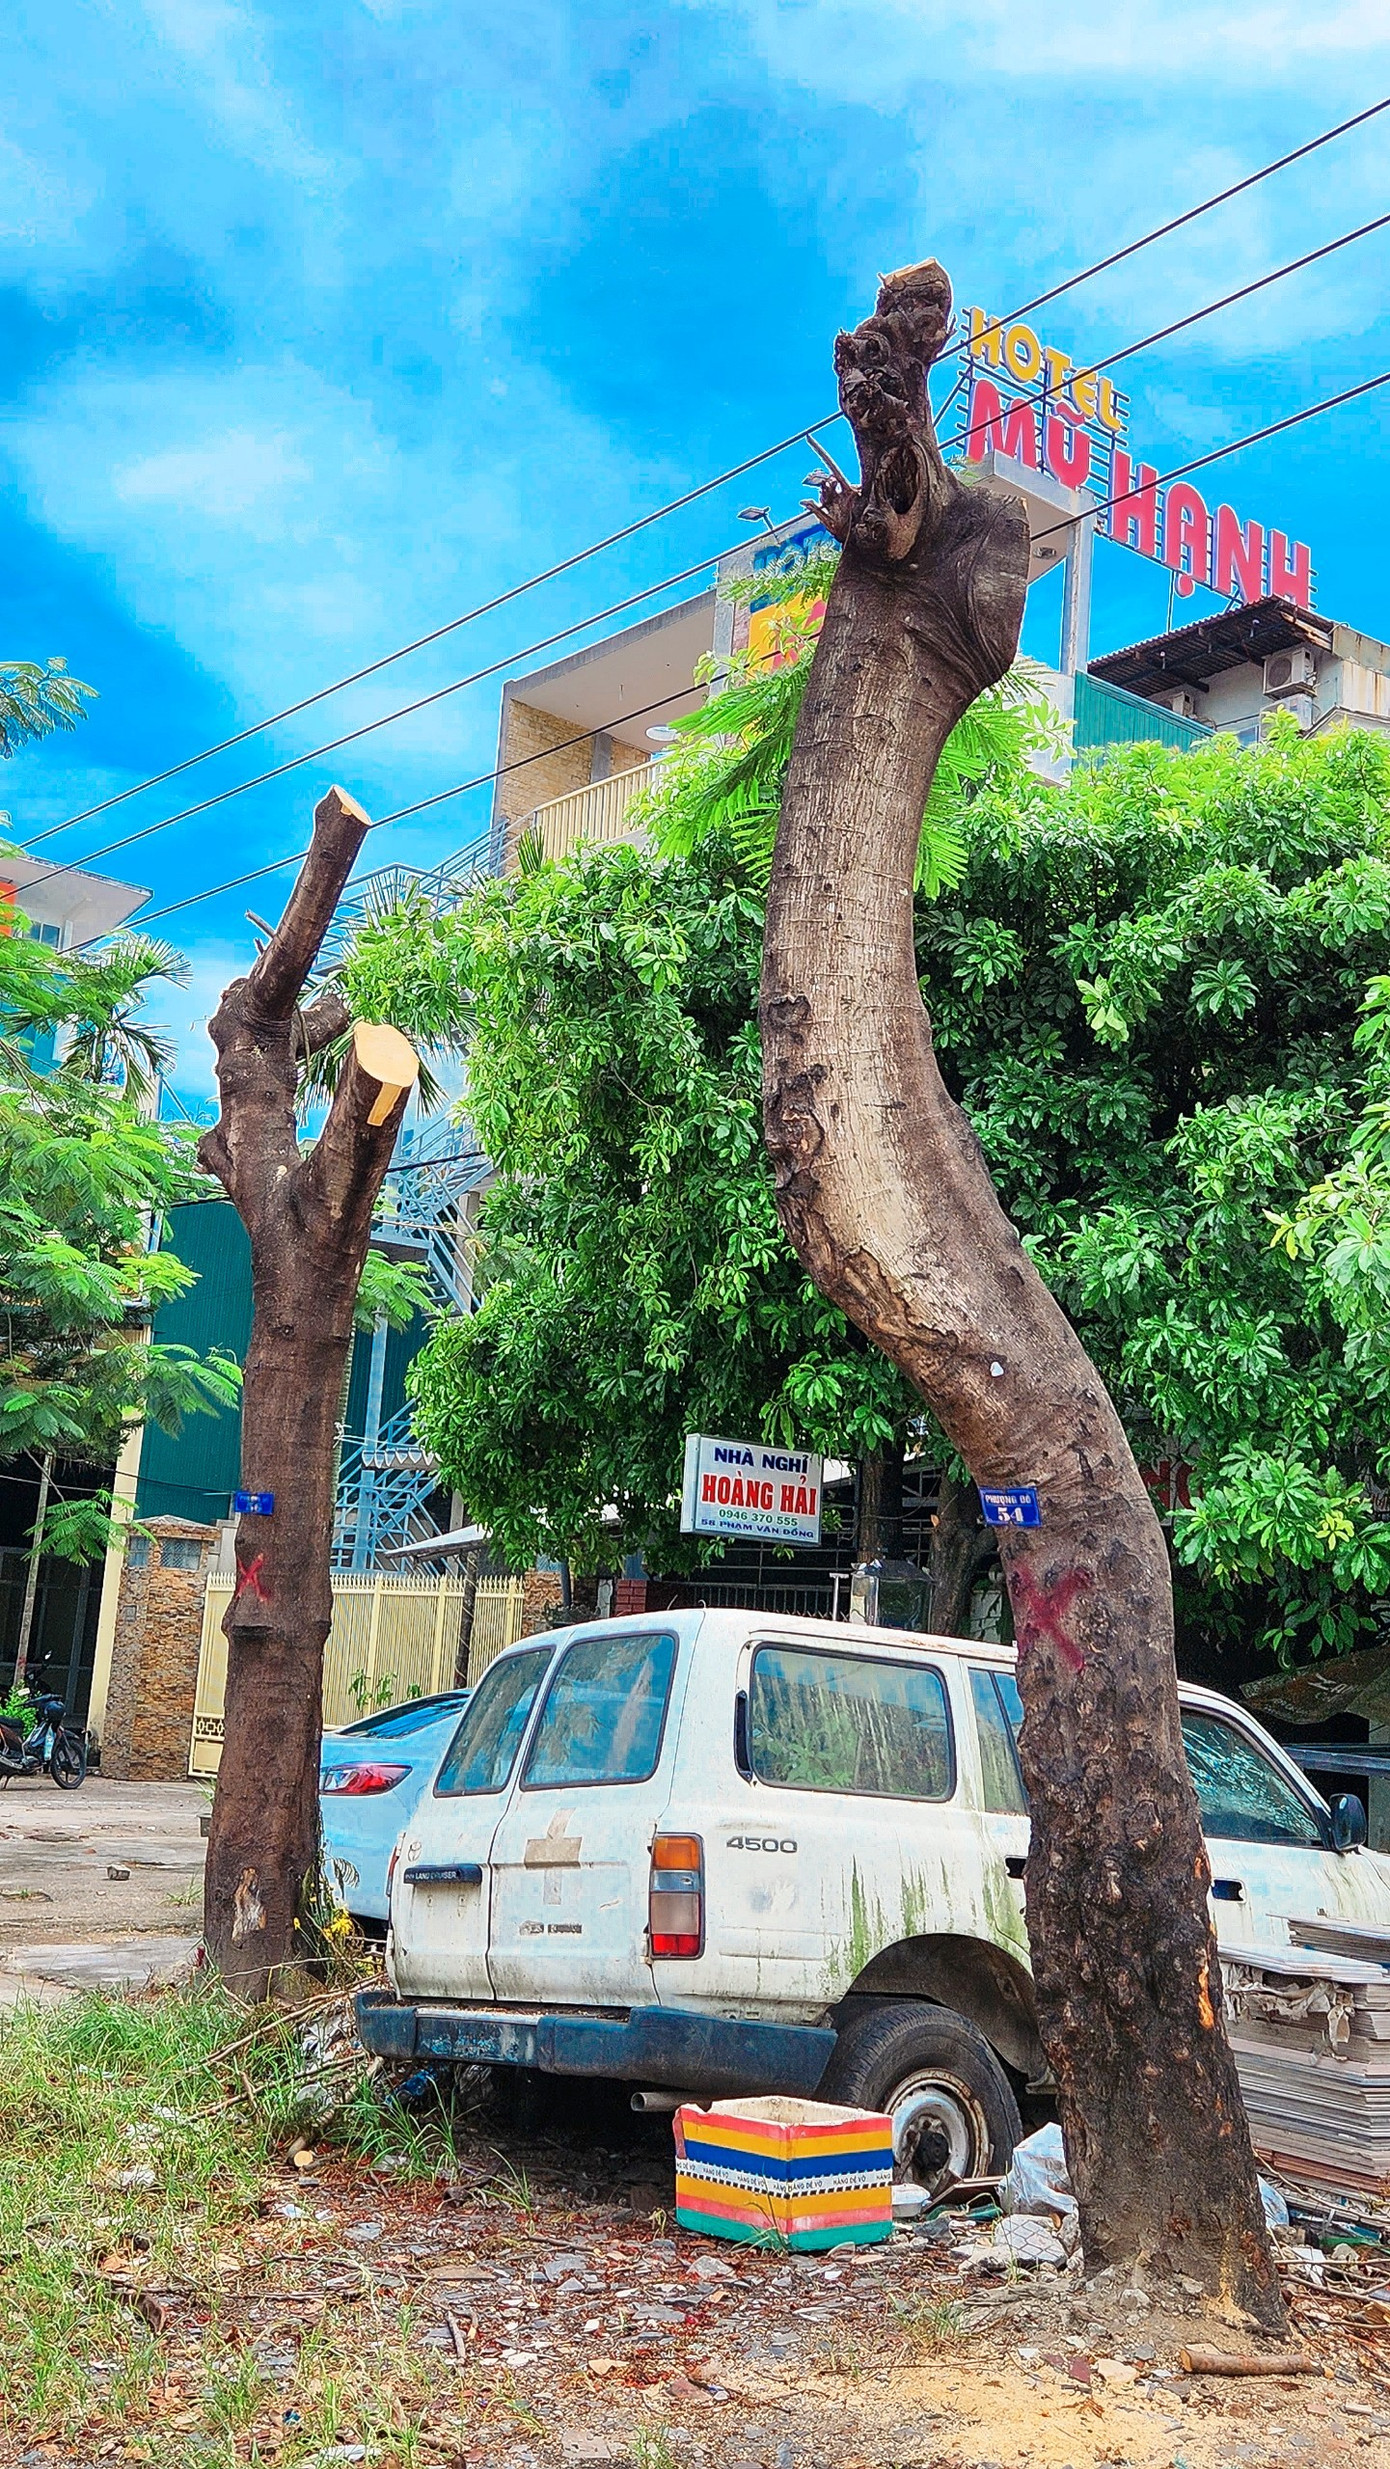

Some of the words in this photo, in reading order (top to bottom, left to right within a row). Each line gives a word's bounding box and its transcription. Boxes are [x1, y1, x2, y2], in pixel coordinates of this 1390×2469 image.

[970, 307, 1121, 432] HOTEL
[1107, 449, 1310, 611] HẠNH
[714, 1447, 754, 1467] NHÀ
[762, 1451, 811, 1474] NGHỈ
[702, 1471, 773, 1510] HOÀNG
[780, 1475, 817, 1515] HẢI
[701, 1519, 716, 1527] 58
[719, 1509, 748, 1521] 0946
[752, 1512, 773, 1524] 370
[776, 1514, 798, 1527] 555
[997, 1507, 1024, 1522] 54
[726, 1836, 798, 1854] 4500
